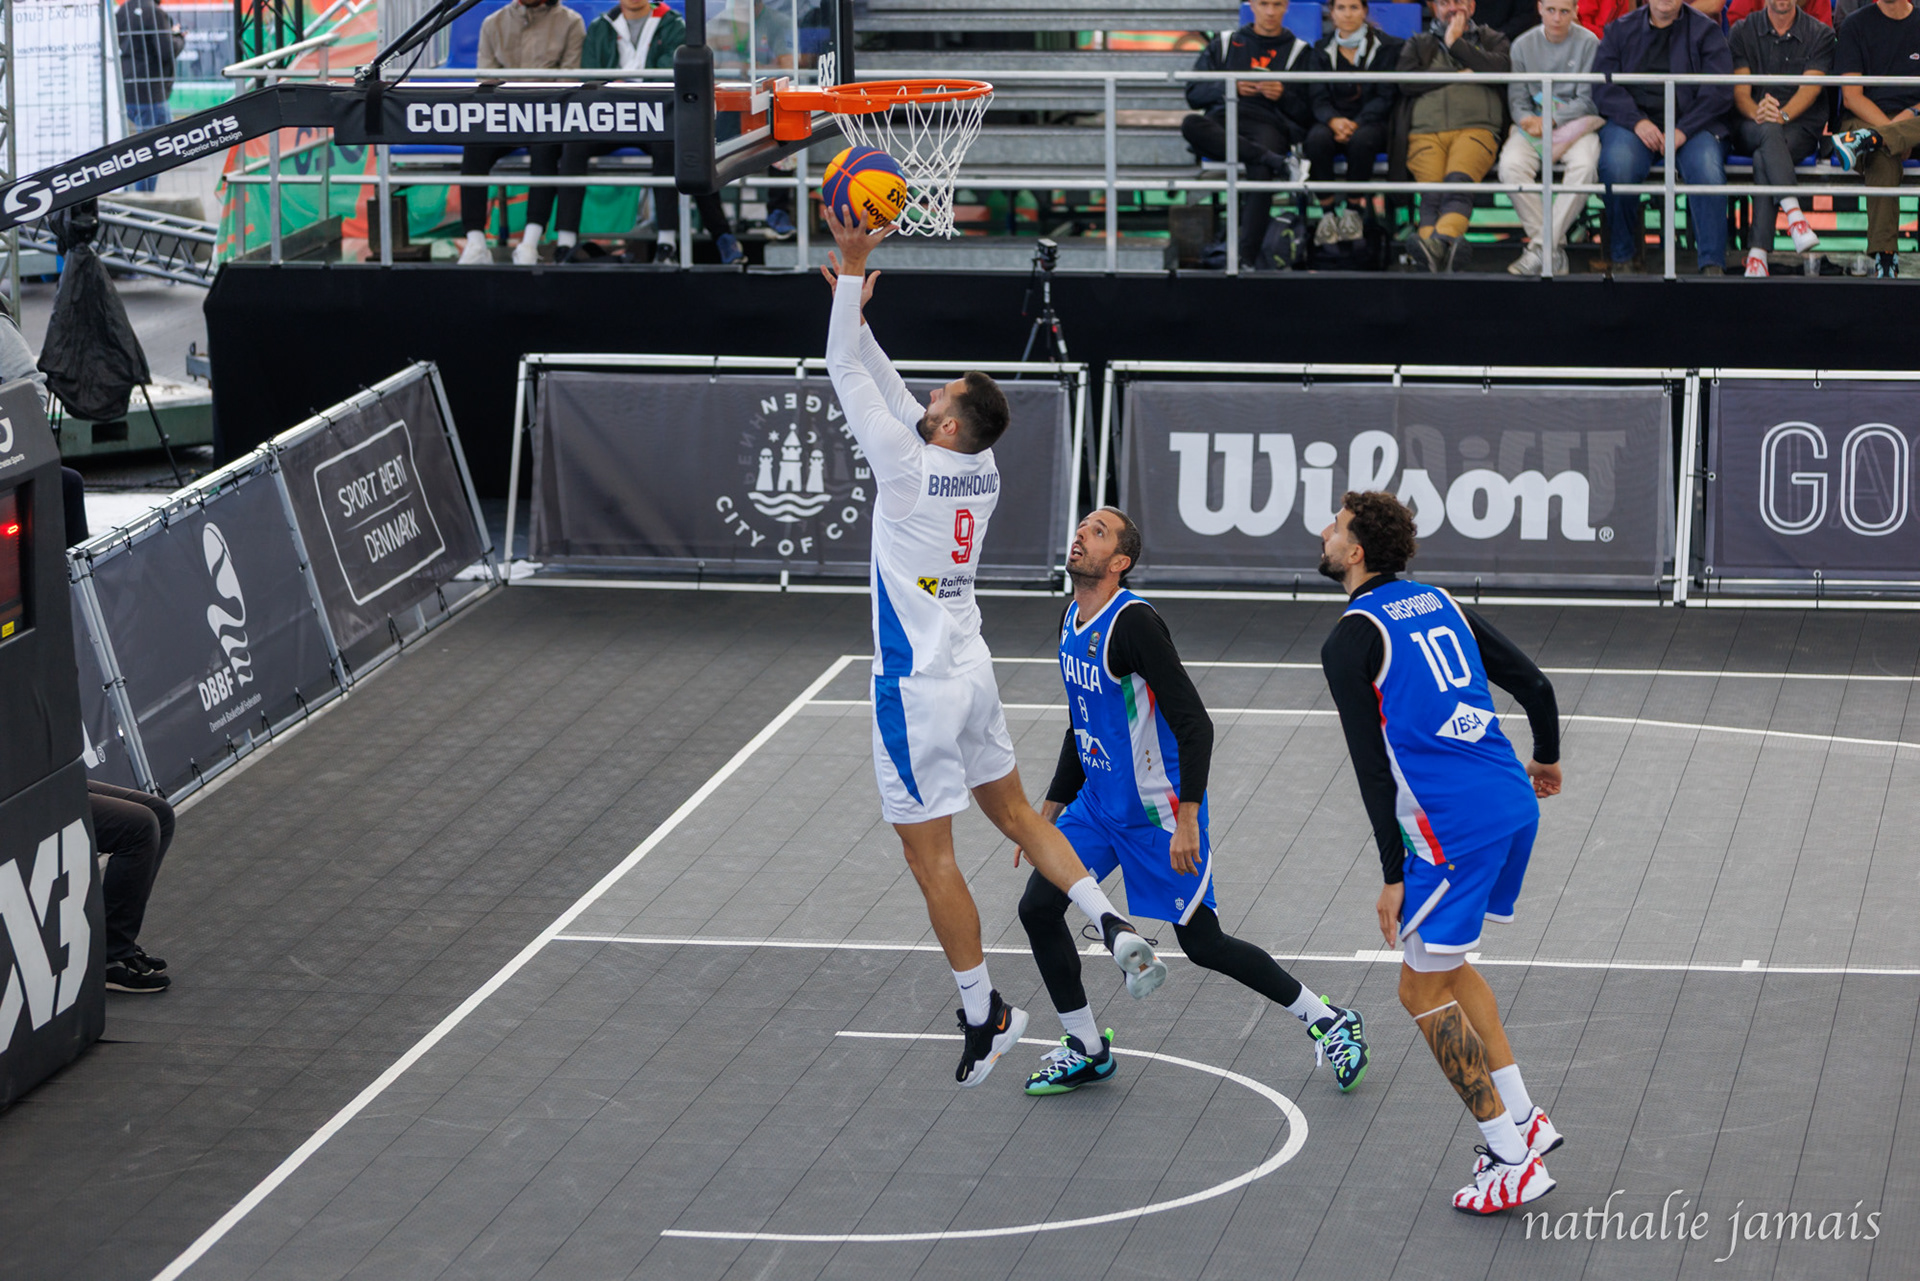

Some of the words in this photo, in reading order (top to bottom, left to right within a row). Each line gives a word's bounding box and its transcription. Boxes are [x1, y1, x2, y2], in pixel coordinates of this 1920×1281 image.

[406, 102, 664, 133] COPENHAGEN
[52, 147, 153, 194] Schelde
[154, 115, 239, 157] Sports
[181, 142, 210, 158] Superior
[209, 139, 219, 147] by
[218, 131, 243, 144] Design
[338, 471, 378, 517] SPORT
[1169, 429, 1597, 541] Wilson
[716, 495, 766, 548] CITY
[777, 536, 814, 557] OF
[951, 508, 975, 565] 9
[938, 587, 963, 599] Bank
[1382, 591, 1444, 621] GASPARDO
[1060, 650, 1103, 695] TALIA
[1409, 625, 1473, 693] 10
[198, 665, 235, 712] DBBF
[1077, 695, 1089, 723] 8
[1452, 712, 1485, 736] IBSA
